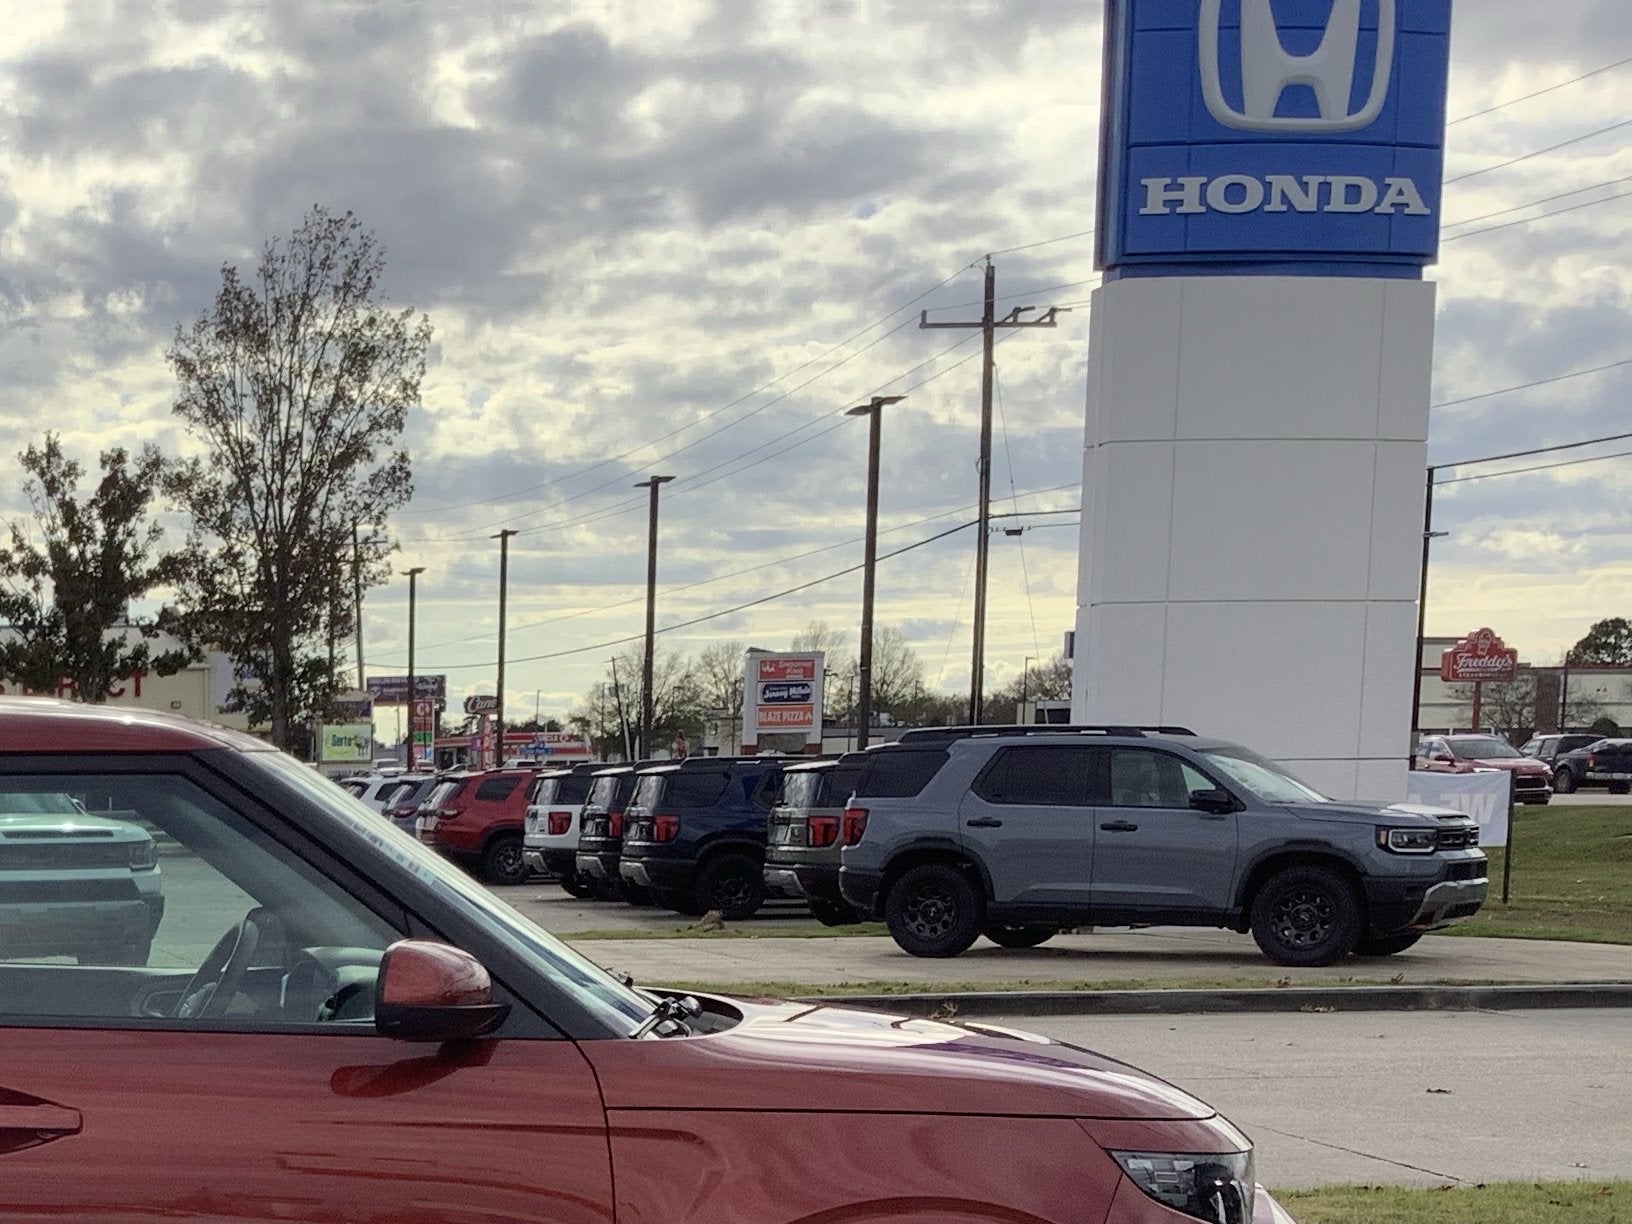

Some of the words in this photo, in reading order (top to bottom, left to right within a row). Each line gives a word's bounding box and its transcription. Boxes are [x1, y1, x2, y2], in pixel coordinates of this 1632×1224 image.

[1139, 175, 1431, 216] HONDA
[1453, 652, 1513, 671] Freddy's
[22, 670, 148, 698] RCT
[468, 697, 498, 713] Cane
[758, 711, 782, 722] BLAZE
[782, 710, 804, 722] PIZZA
[331, 734, 352, 747] Serta
